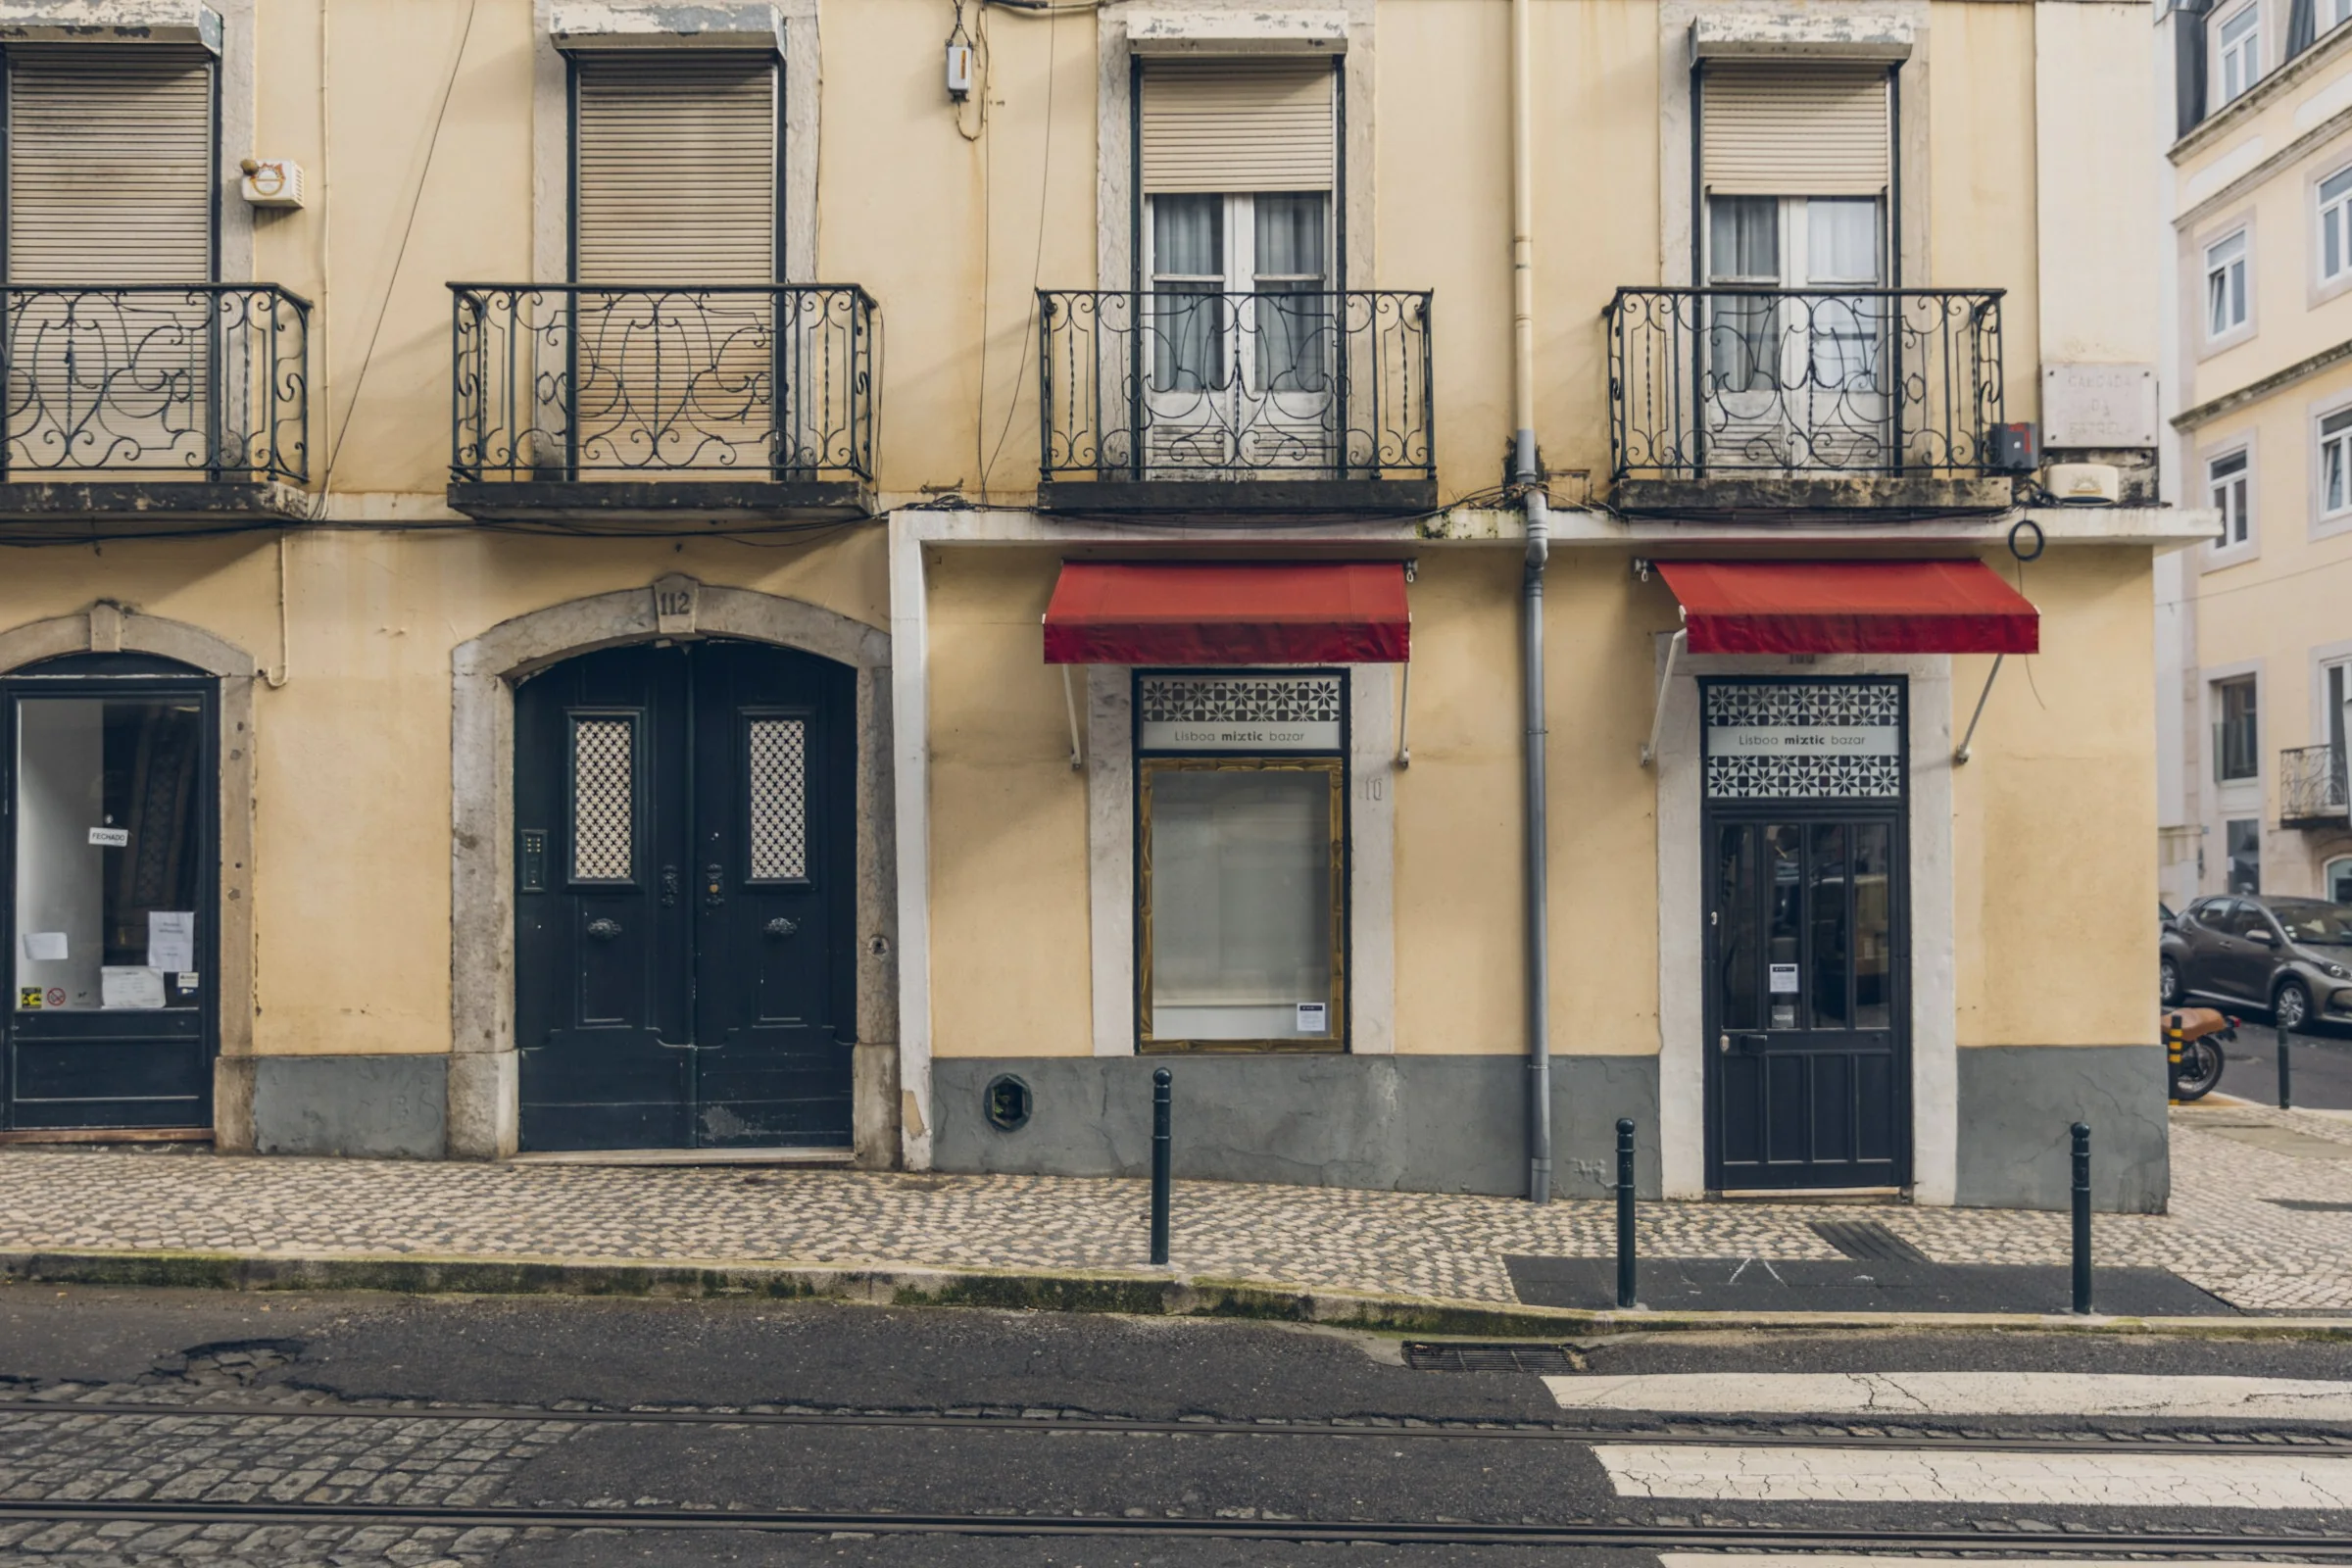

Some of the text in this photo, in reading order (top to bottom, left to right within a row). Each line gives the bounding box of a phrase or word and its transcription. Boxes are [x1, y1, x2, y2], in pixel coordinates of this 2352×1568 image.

[661, 591, 690, 615] 112
[1174, 730, 1304, 742] Lisboa mixtic bazar
[1739, 734, 1866, 746] Lisboa mixtic bazar
[91, 832, 125, 842] FECHADO
